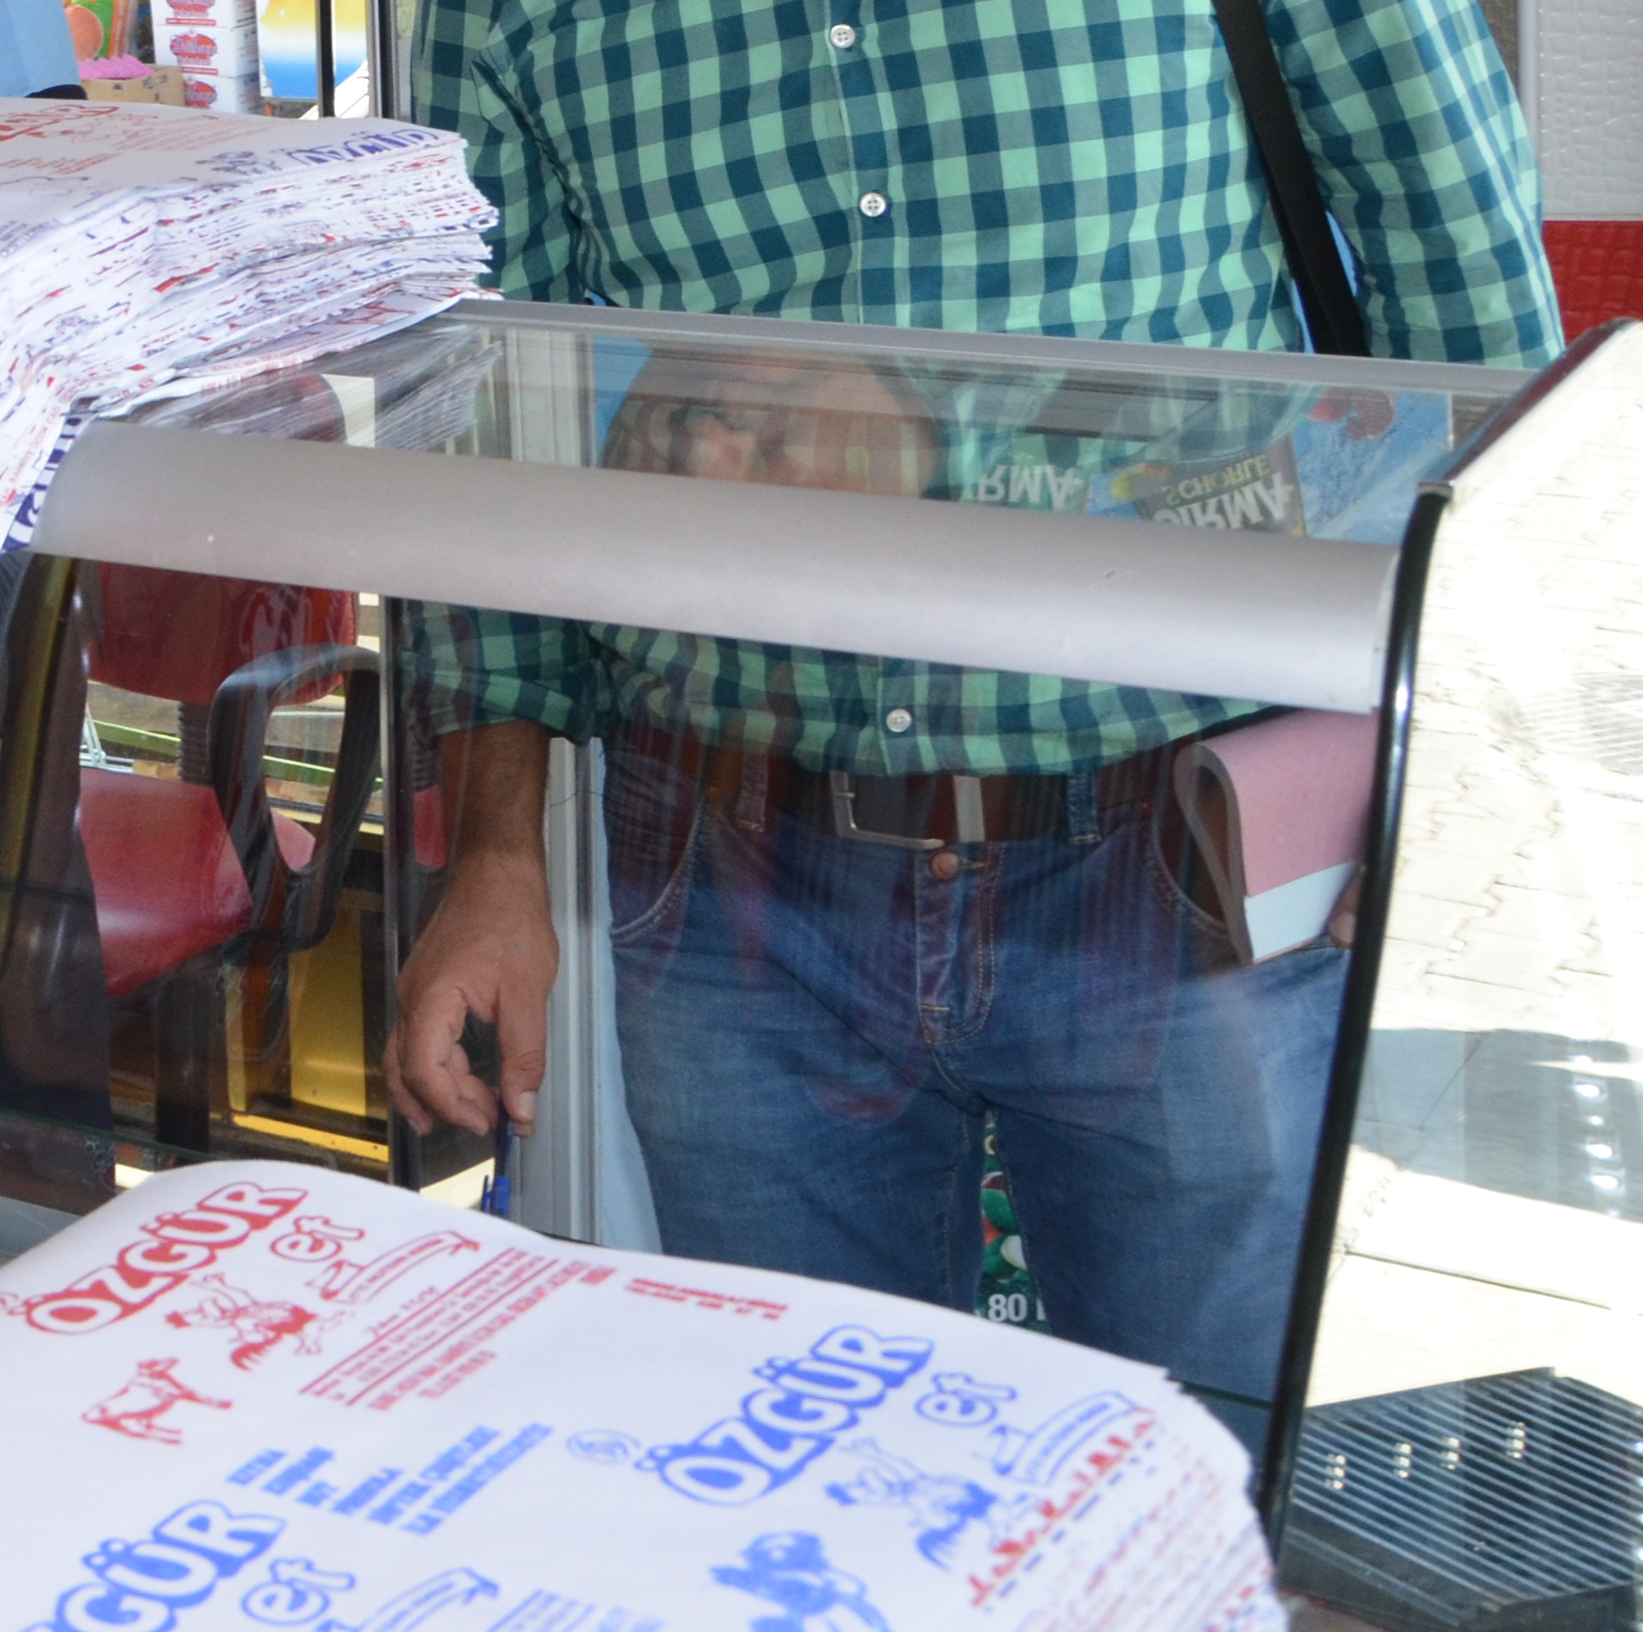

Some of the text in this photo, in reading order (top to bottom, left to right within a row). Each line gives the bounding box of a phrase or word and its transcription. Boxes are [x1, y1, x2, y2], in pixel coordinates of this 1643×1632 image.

[24, 1181, 308, 1334] ÖZGÜR
[270, 1215, 366, 1261] et
[988, 1293, 1028, 1322] 80
[634, 1324, 933, 1507] ÖZGÜR
[915, 1371, 1016, 1428] et
[45, 1499, 287, 1632] GÜR
[239, 1555, 356, 1626] et
